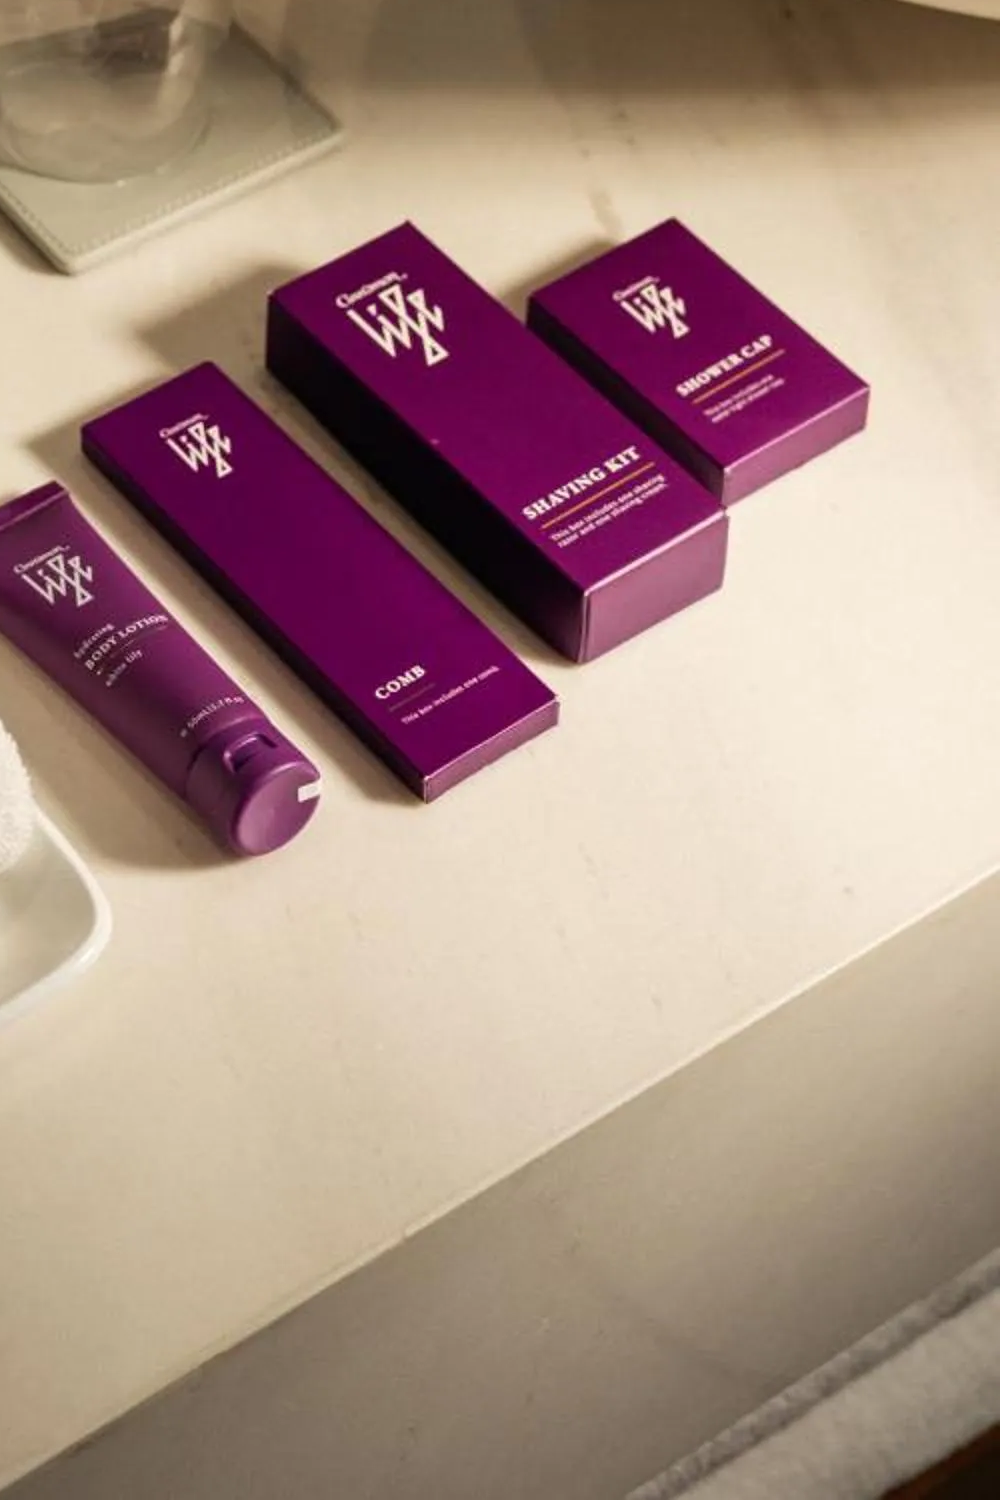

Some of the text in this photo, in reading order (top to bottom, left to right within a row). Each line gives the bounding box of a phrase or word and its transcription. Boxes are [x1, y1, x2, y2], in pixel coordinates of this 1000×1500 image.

[676, 354, 744, 397] SHOWER
[740, 334, 772, 358] CAP
[522, 445, 641, 520] SHAVING KIT
[84, 615, 168, 670] BODY LOTION
[375, 665, 425, 699] COMB
